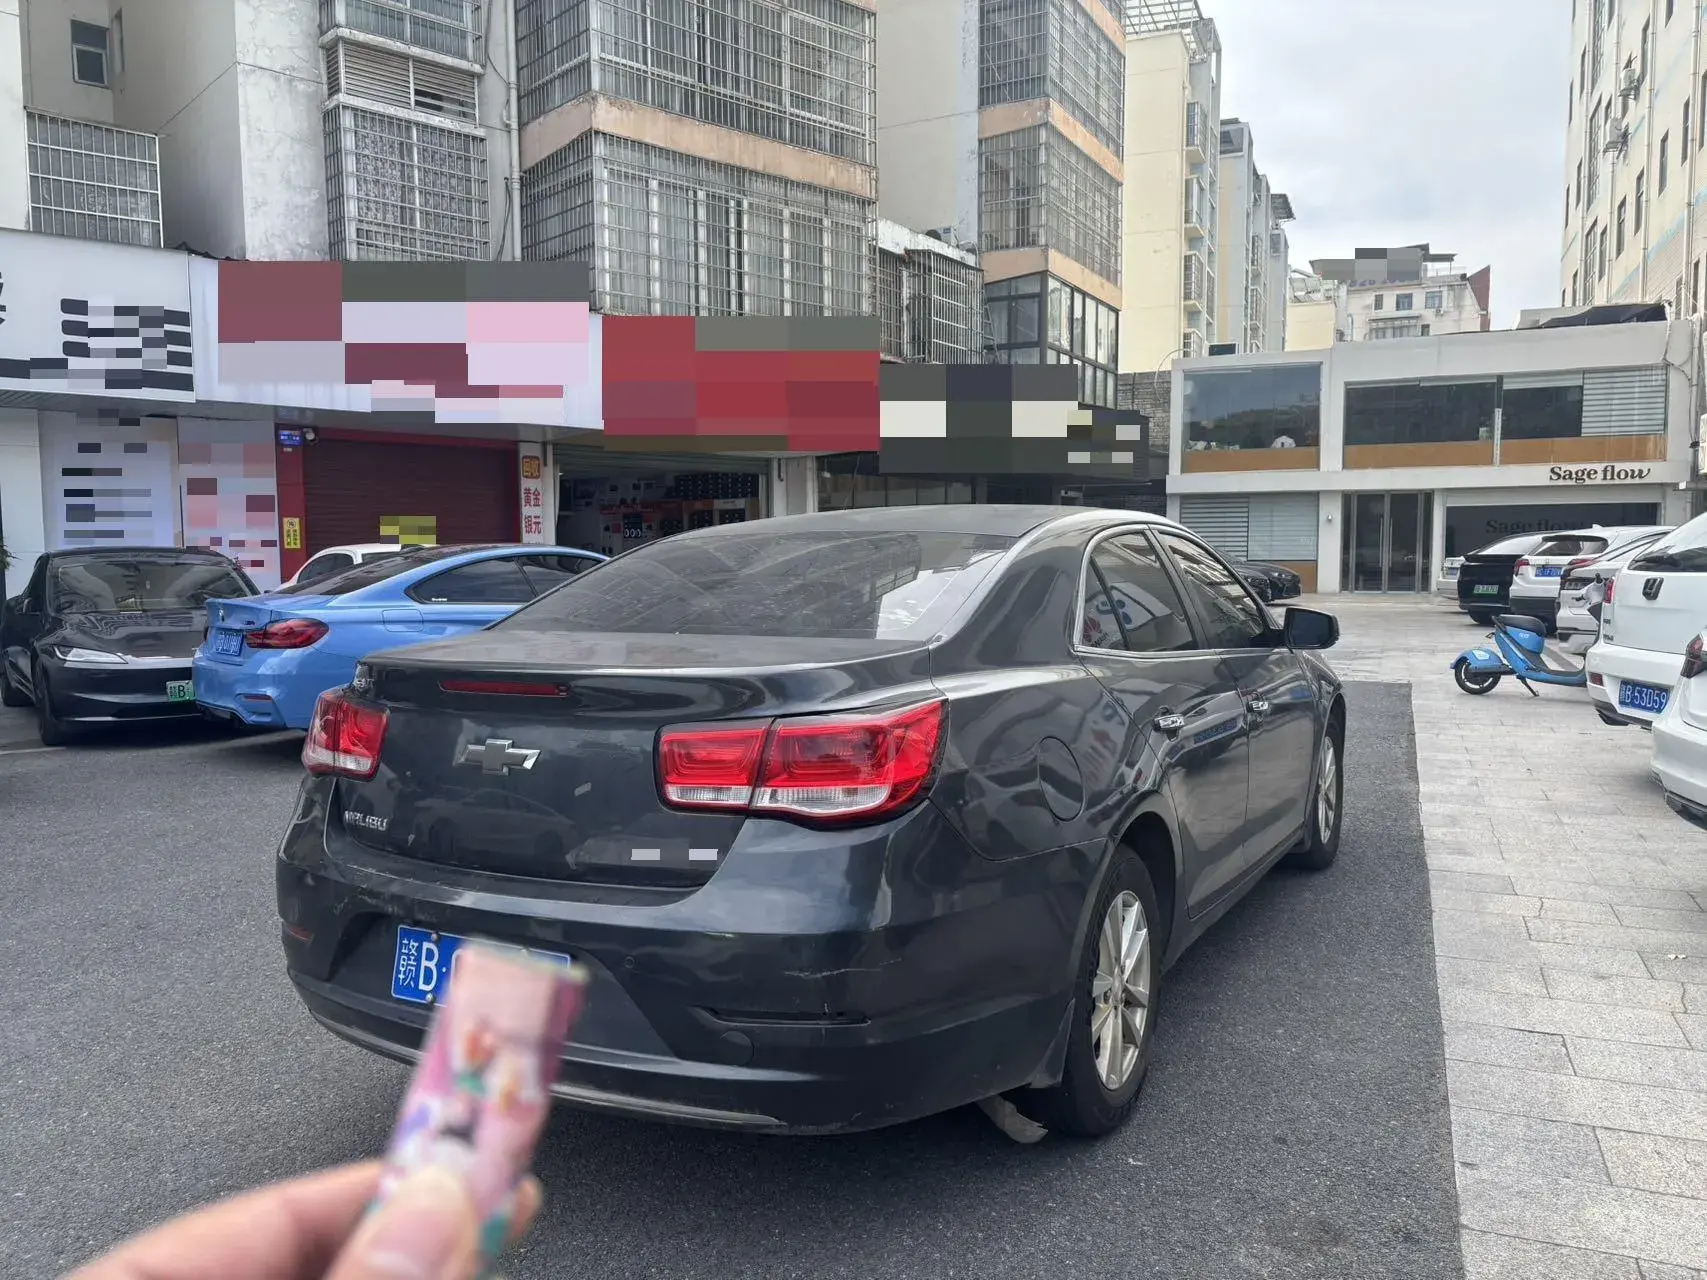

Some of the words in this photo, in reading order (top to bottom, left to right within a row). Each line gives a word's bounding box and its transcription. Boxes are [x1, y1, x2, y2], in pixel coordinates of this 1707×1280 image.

[1549, 466, 1598, 484] Sage
[1601, 465, 1651, 481] flow
[523, 487, 541, 507] 黄金
[524, 515, 542, 534] 银元
